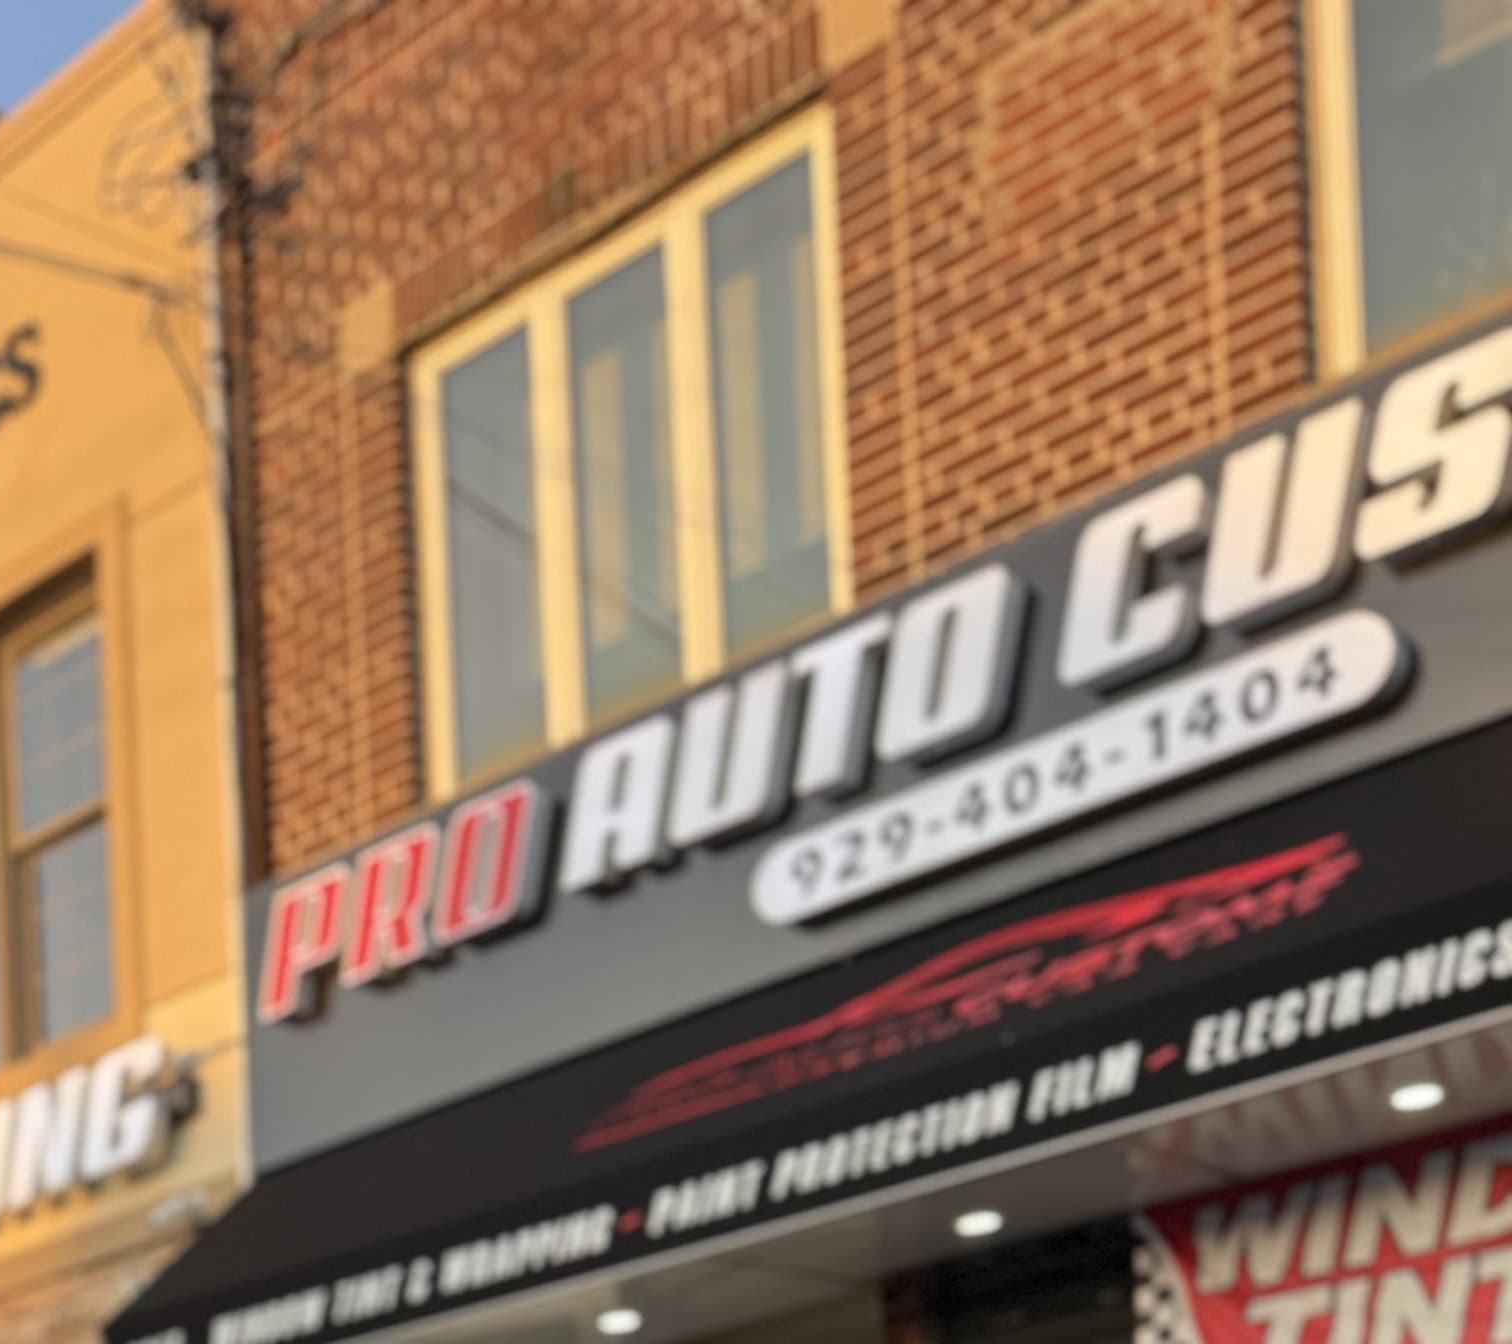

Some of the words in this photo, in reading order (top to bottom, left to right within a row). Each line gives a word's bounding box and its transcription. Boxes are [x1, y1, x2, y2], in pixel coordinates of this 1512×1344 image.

[258, 778, 538, 1024] PRO
[561, 562, 1014, 892] AUTO
[1056, 324, 1512, 688] CUS
[790, 646, 1344, 898] 929-404-1404
[330, 1263, 404, 1326] TINT
[404, 1256, 435, 1305] &
[438, 1204, 618, 1294] WRAPPING
[644, 1158, 768, 1238] PAINT
[769, 1079, 1023, 1202] PROTECTION
[1025, 1040, 1143, 1124] FILM
[1186, 917, 1512, 1075] ELECTRONICS
